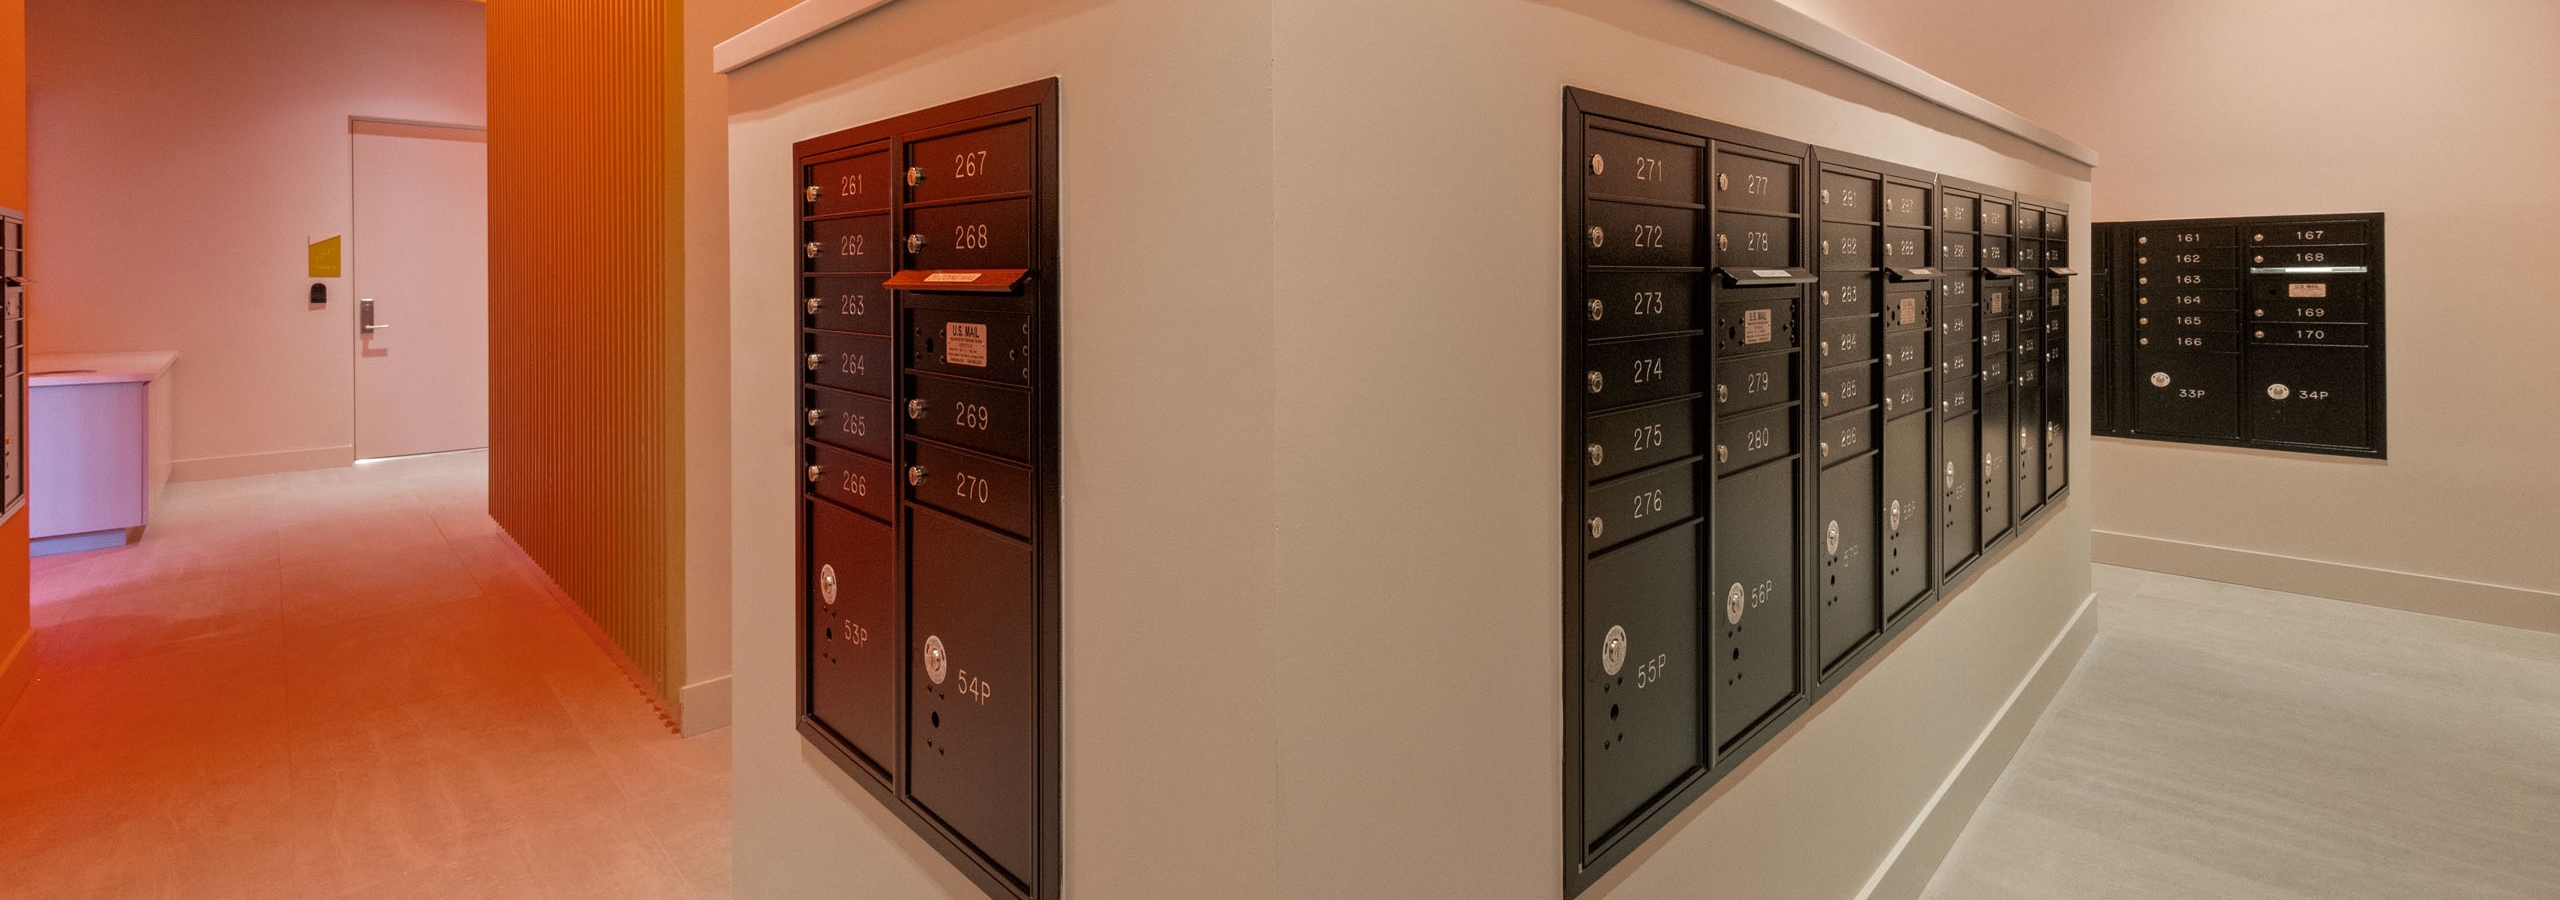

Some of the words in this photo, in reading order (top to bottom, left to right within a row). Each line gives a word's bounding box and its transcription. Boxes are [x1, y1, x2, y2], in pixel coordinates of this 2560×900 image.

[955, 151, 987, 178] 267
[1636, 156, 1662, 182] 271
[841, 173, 863, 197] 261
[1748, 174, 1769, 195] 277
[841, 234, 864, 256] 262
[955, 224, 988, 250] 268
[1634, 224, 1663, 248] 272
[1747, 231, 1769, 252] 278
[2177, 233, 2200, 243] 161
[2296, 230, 2324, 240] 167
[2176, 254, 2201, 263] 162
[2296, 252, 2325, 262] 168
[2176, 275, 2201, 284] 163
[841, 294, 865, 316] 263
[1634, 291, 1663, 316] 273
[2176, 295, 2201, 305] 164
[2296, 307, 2325, 317] 169
[965, 325, 980, 339] MAIL
[2176, 316, 2202, 325] 165
[2177, 337, 2202, 346] 166
[2296, 330, 2325, 339] 170
[842, 352, 865, 376] 264
[1633, 357, 1663, 383] 274
[1747, 371, 1769, 394] 279
[2179, 388, 2206, 399] 33P
[2299, 390, 2329, 400] 34P
[842, 412, 866, 437] 265
[956, 401, 988, 431] 269
[1633, 423, 1662, 452] 275
[1747, 427, 1769, 451] 280
[843, 470, 866, 497] 266
[956, 472, 989, 503] 270
[1633, 489, 1662, 519] 276
[1751, 579, 1773, 609] 56P
[844, 619, 868, 648] 53P
[1637, 653, 1667, 689] 55P
[957, 668, 991, 706] 54P
